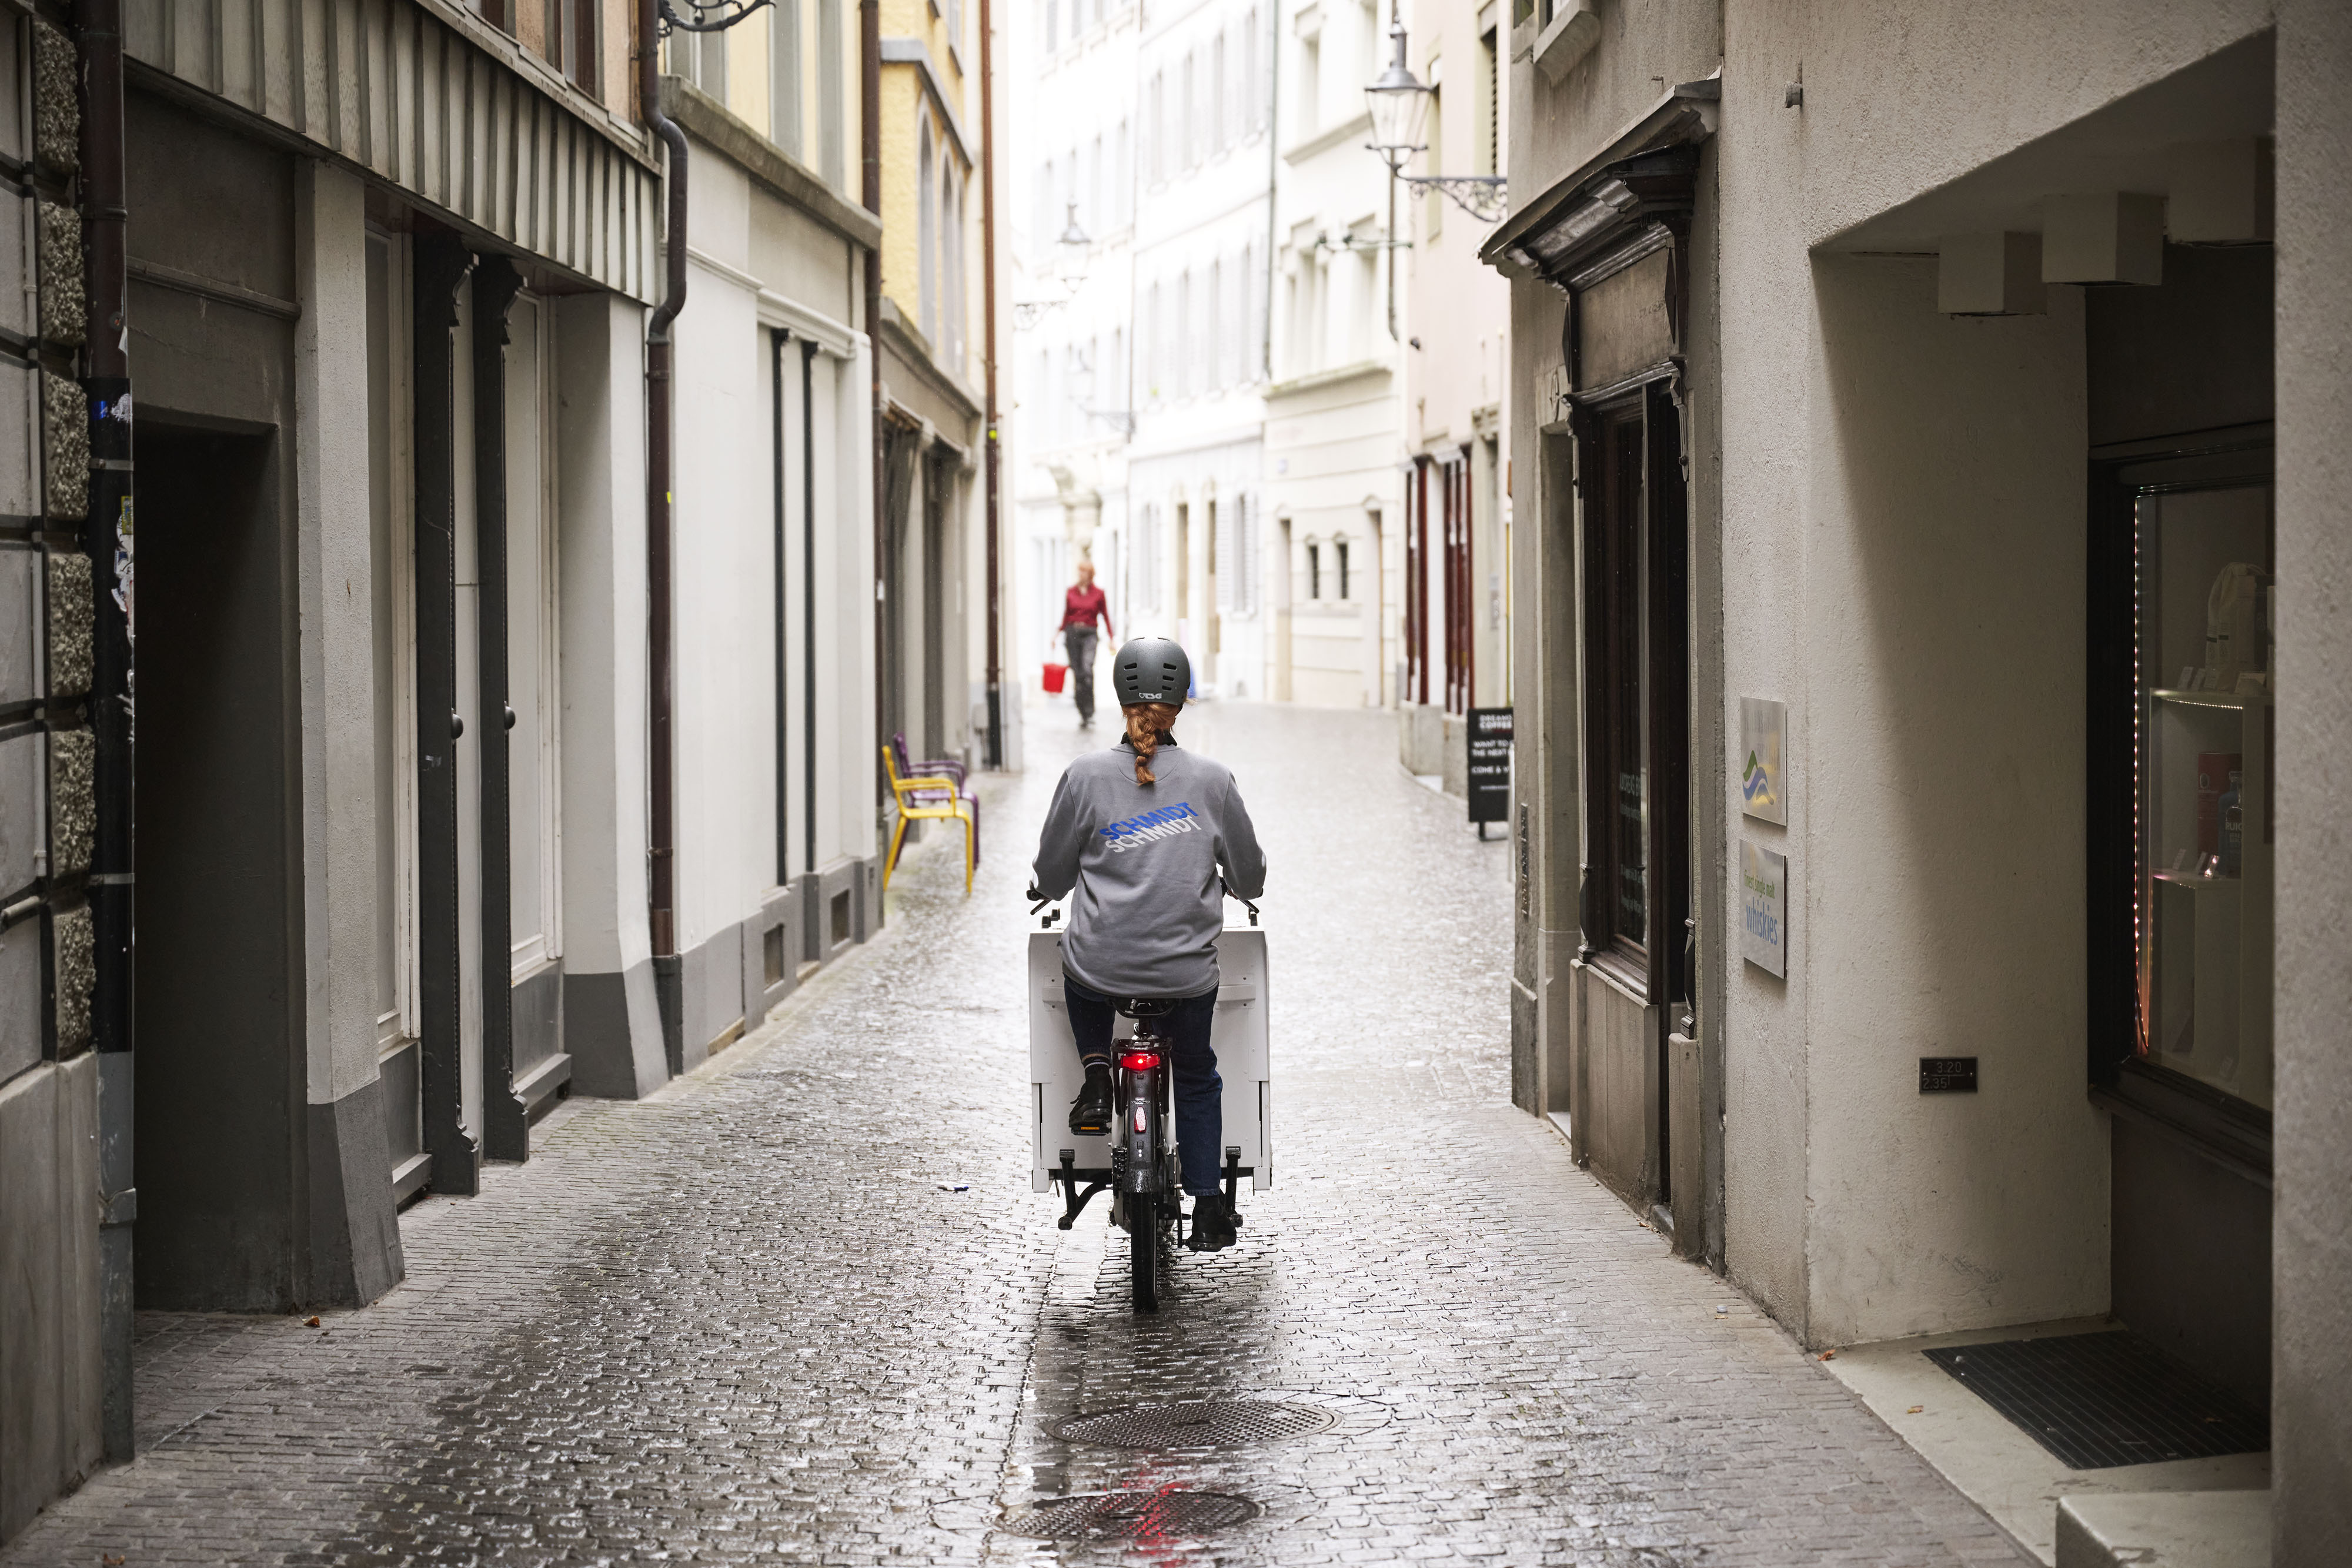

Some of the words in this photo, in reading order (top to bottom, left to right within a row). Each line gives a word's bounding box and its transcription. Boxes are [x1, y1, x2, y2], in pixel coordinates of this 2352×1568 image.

[1100, 802, 1198, 840] SCHMIDT
[1105, 815, 1201, 852] SCHMIDT
[1744, 870, 1754, 891] finest
[1755, 874, 1765, 898] single
[1766, 881, 1775, 899] malt
[1746, 897, 1778, 945] whiskies
[1923, 1078, 1947, 1089] 2.35
[1936, 1062, 1962, 1073] 3.20
